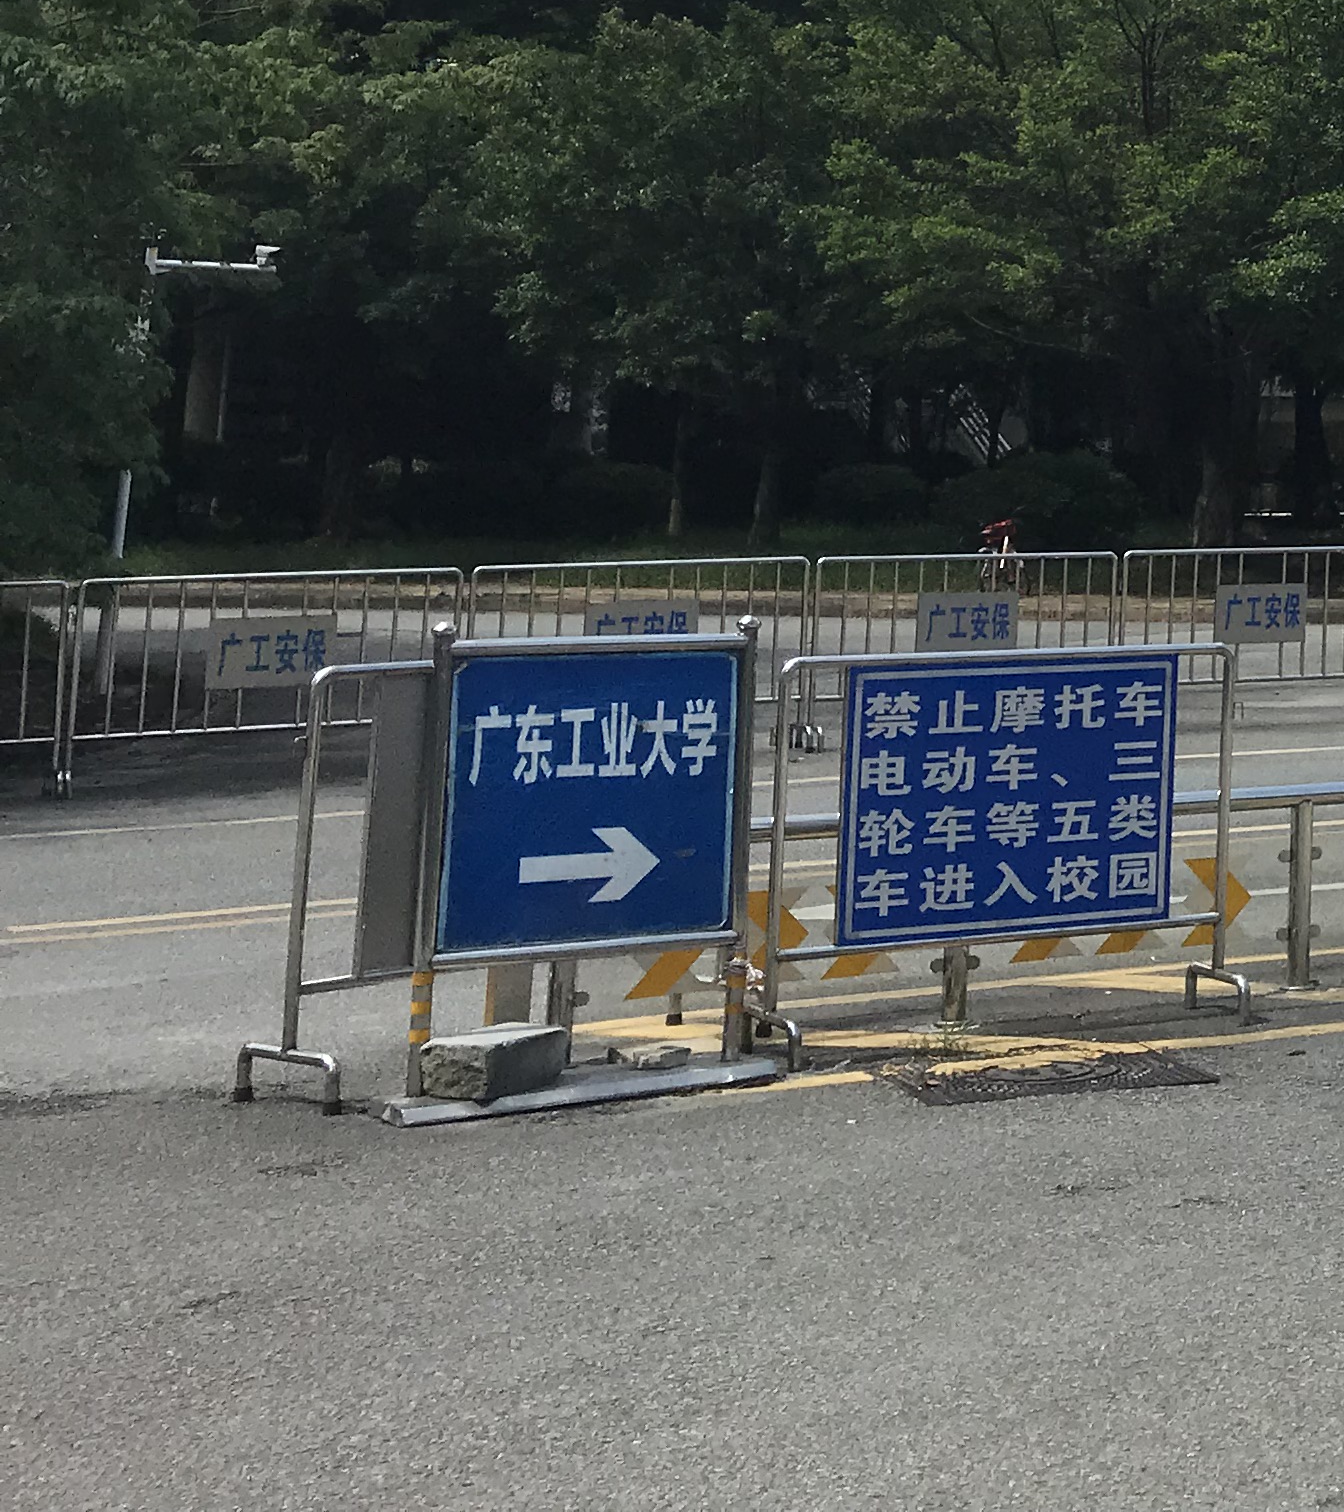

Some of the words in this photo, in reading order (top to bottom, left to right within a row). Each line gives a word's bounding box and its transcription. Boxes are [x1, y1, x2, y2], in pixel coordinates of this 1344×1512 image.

[925, 602, 1010, 641] 广工安保
[1225, 592, 1300, 630] 广工安保
[217, 628, 326, 676] 广工安保
[864, 681, 1163, 739] 禁止摩托车
[468, 698, 717, 787] 广东工业大学
[860, 741, 1160, 796] 电动车、三
[858, 794, 1157, 857] 轮车等五类
[854, 852, 1158, 917] 车进入校园
